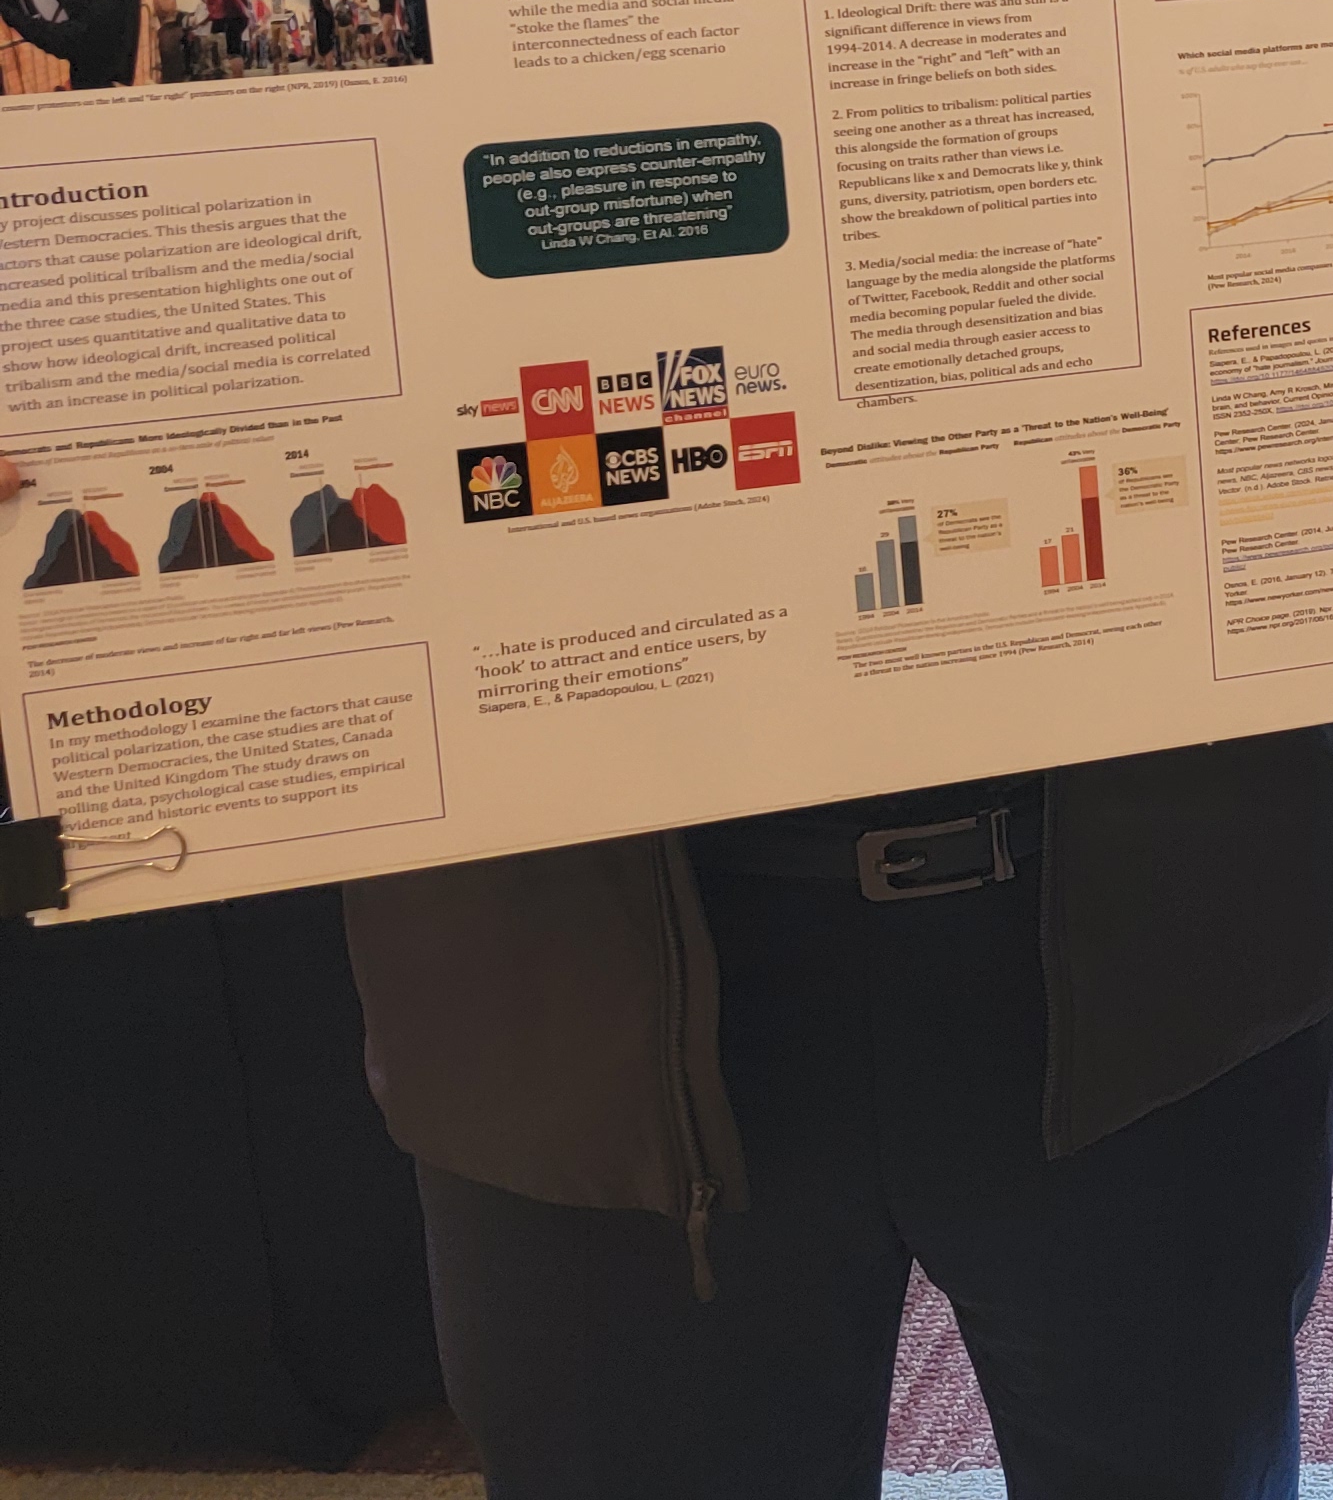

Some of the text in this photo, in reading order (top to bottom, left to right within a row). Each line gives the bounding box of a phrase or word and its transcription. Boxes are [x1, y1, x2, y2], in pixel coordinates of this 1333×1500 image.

[1208, 321, 1310, 342] References
[600, 372, 650, 391] BBC
[680, 362, 723, 388] FOX
[734, 362, 780, 380] euro
[456, 399, 518, 418] sky news
[530, 384, 584, 416] CNN
[598, 394, 656, 416] NEWS
[670, 384, 726, 410] NEWS
[621, 447, 660, 468] CBS
[672, 443, 728, 474] HBO
[738, 439, 794, 462] ESPN
[606, 466, 661, 487] NEWS
[472, 489, 521, 512] NBC
[541, 637, 554, 649] is
[558, 624, 636, 650] produced
[640, 620, 670, 635] and
[674, 608, 754, 632] circulated
[758, 609, 774, 619] as
[778, 608, 787, 617] a
[46, 694, 214, 732] Methodology
